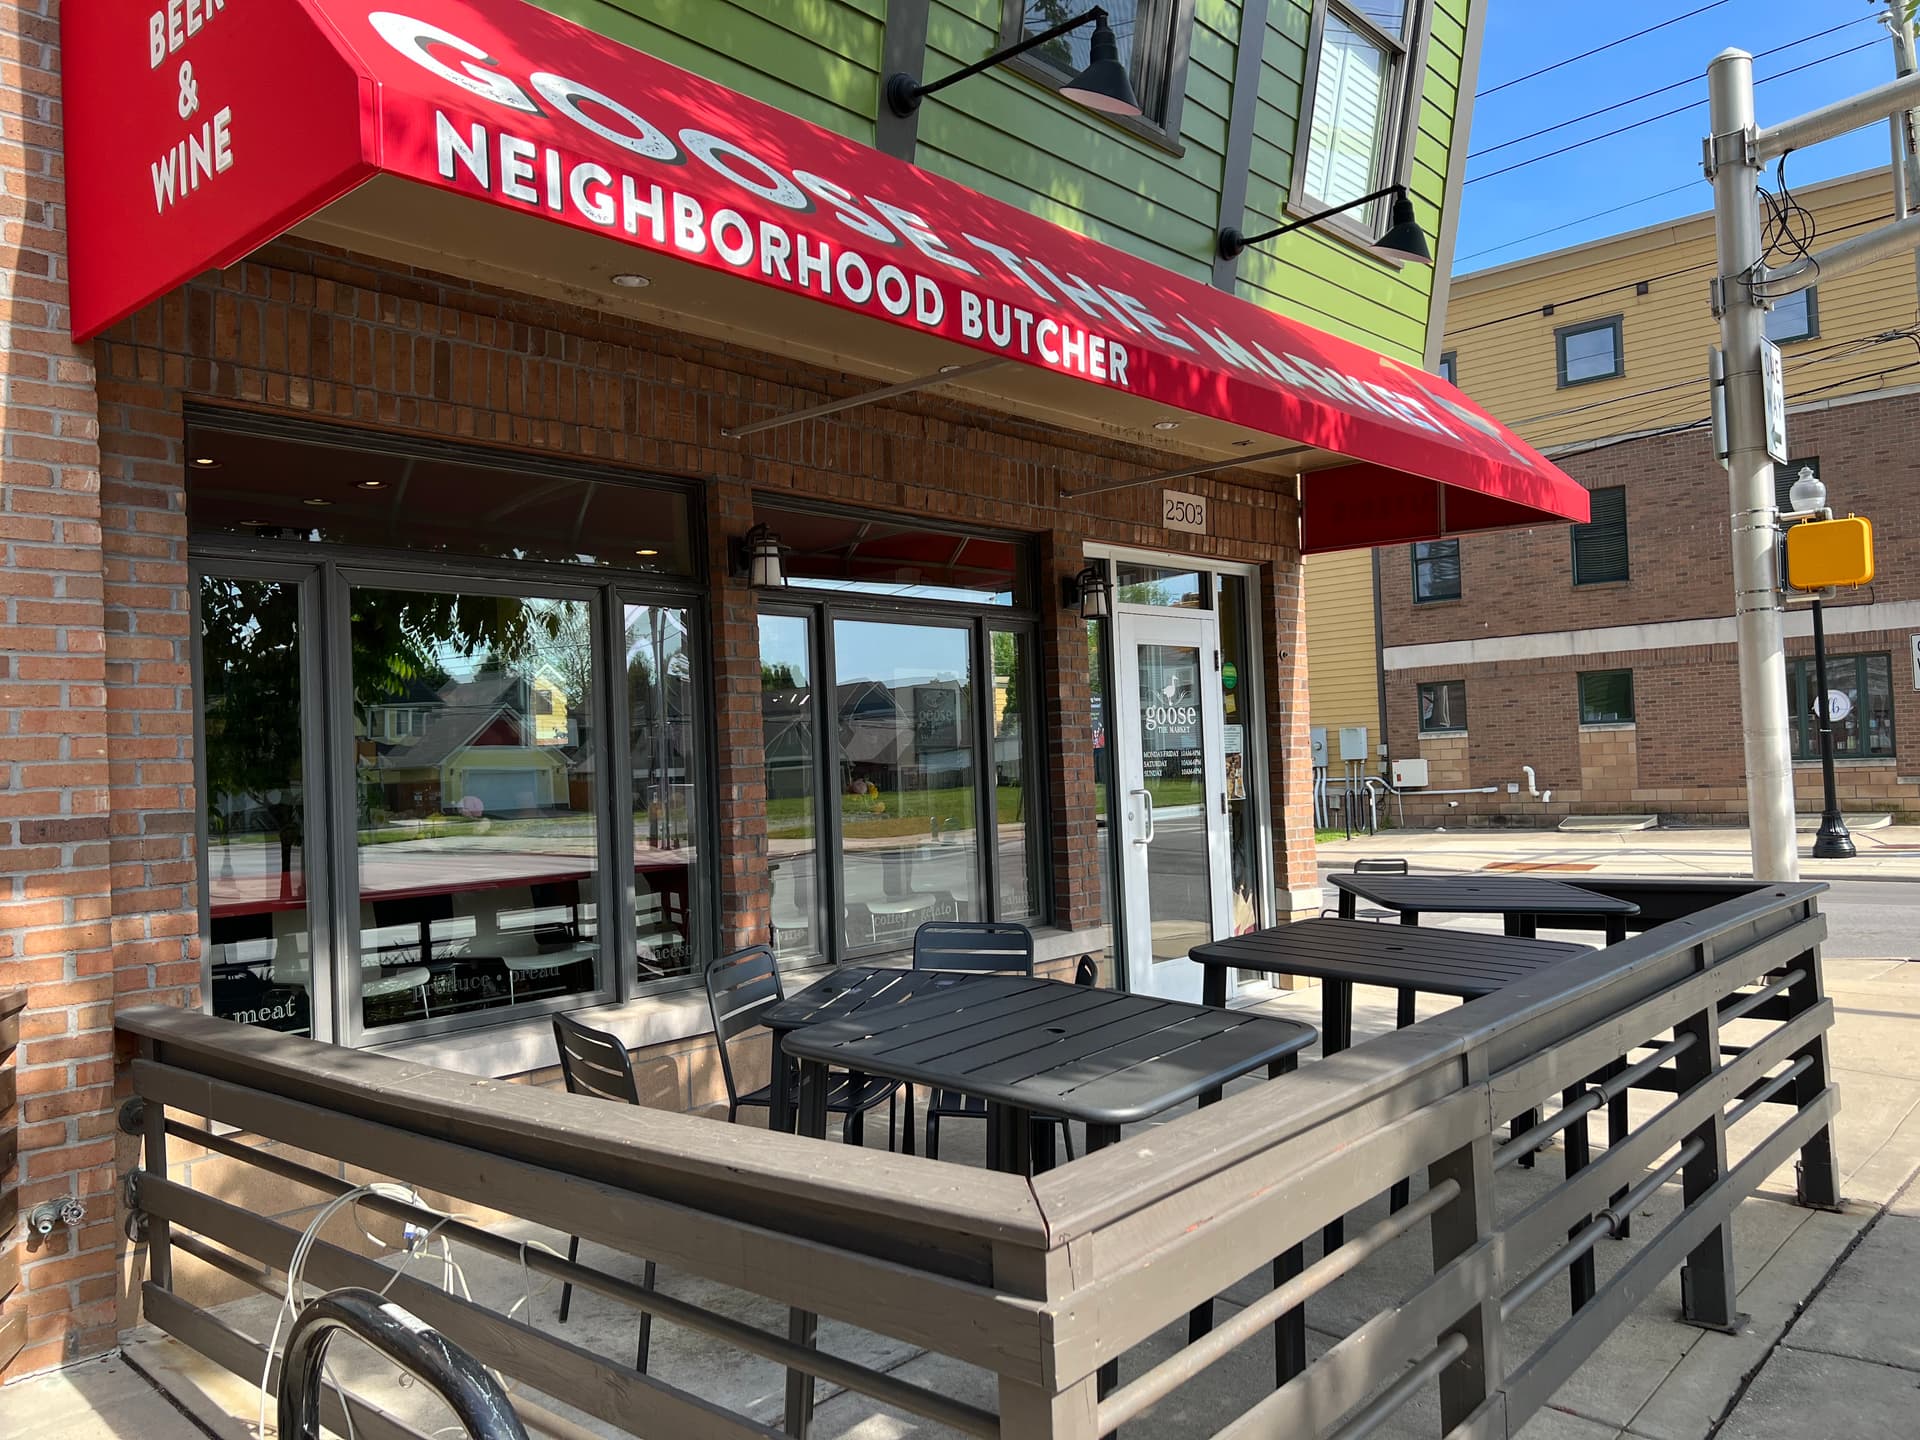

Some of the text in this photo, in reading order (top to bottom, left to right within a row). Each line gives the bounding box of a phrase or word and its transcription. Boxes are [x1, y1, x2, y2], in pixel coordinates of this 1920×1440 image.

[177, 60, 199, 119] &
[150, 106, 234, 214] WINE
[367, 11, 1464, 443] GOOSE THE MARKET
[434, 110, 1129, 386] NEIGHBORHOOD BUTCHER
[1764, 351, 1780, 385] ONE
[1164, 499, 1204, 527] 2503
[1145, 704, 1197, 731] goose
[1157, 725, 1190, 734] THE MARKET
[232, 995, 297, 1025] meat
